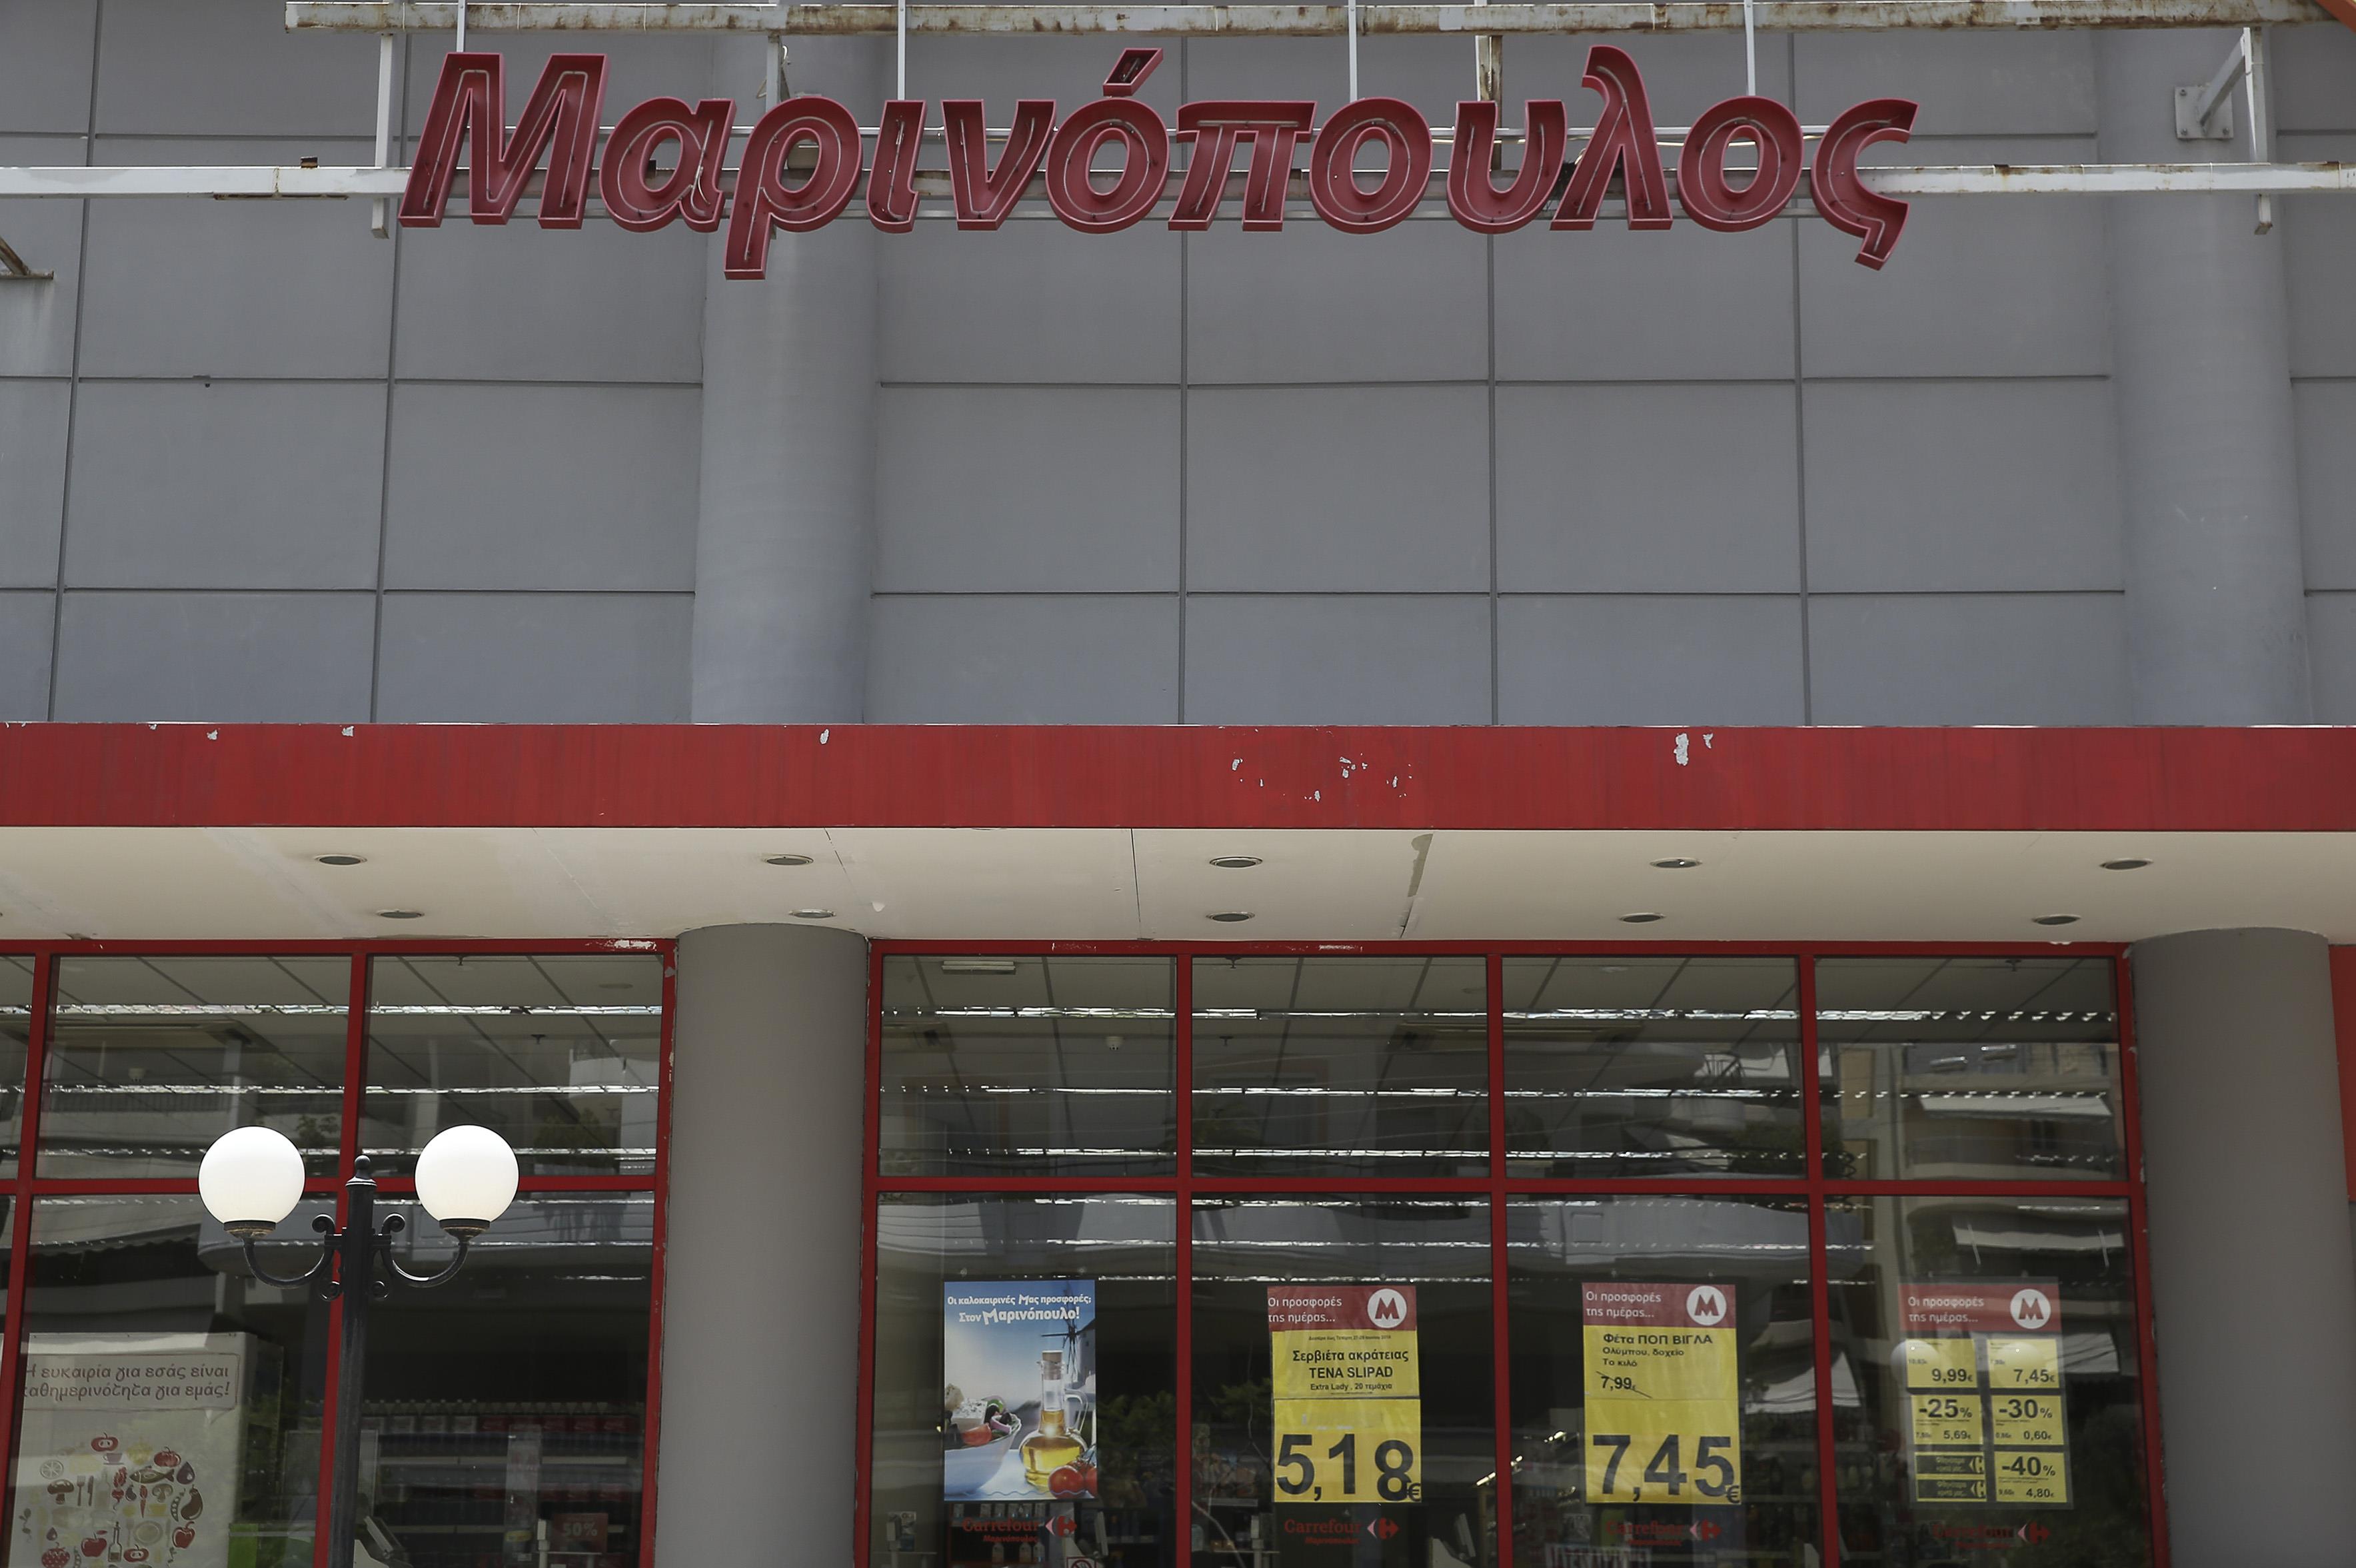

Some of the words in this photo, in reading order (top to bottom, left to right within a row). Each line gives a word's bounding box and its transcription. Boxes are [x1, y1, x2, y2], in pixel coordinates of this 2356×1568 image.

[398, 44, 1919, 280] Μαρινόπουλος
[948, 1296, 958, 1305] Οι
[958, 1295, 1016, 1305] καλοκαιρινές
[1018, 1293, 1039, 1305] Μας
[1040, 1293, 1092, 1306] προσφορές;
[1268, 1297, 1280, 1307] Οι
[1282, 1296, 1342, 1311] προσφορές
[1586, 1291, 1598, 1301] Οι
[1601, 1291, 1662, 1305] προσφορές
[1908, 1297, 1920, 1307] Οι
[1923, 1297, 1984, 1310] προσφορές
[959, 1311, 982, 1323] Στον
[982, 1305, 1080, 1325] Μαρινόπουλο!
[1268, 1313, 1286, 1323] της
[1288, 1311, 1336, 1324] ημέρας...
[1586, 1307, 1604, 1317] της
[1606, 1306, 1654, 1319] ημέρας...
[1908, 1313, 1925, 1323] της
[1928, 1311, 1978, 1323] ημέρας...
[1603, 1333, 1634, 1344] Φέτα
[1638, 1335, 1668, 1345] ΠΟΠ
[1673, 1334, 1714, 1345] ΒΙΓΛΑ
[1292, 1349, 1344, 1363] Σερβιέτα
[1348, 1349, 1408, 1362] ακράτειας
[1652, 1348, 1684, 1357] δοχείο
[41, 1364, 111, 1382] ευκαιρία
[115, 1366, 141, 1382] για
[145, 1363, 186, 1380] εσάς
[191, 1363, 229, 1378] είναι
[1309, 1367, 1344, 1379] TENA
[1347, 1366, 1393, 1378] SLIPAD
[155, 1384, 181, 1401] για
[185, 1381, 230, 1399] εμάς!
[1331, 1383, 1349, 1392] Lady
[1365, 1382, 1392, 1391] τεμάχια
[563, 1521, 598, 1537] 50%
[962, 1517, 1040, 1533] Carrefour
[1284, 1519, 1362, 1534] Carrefour
